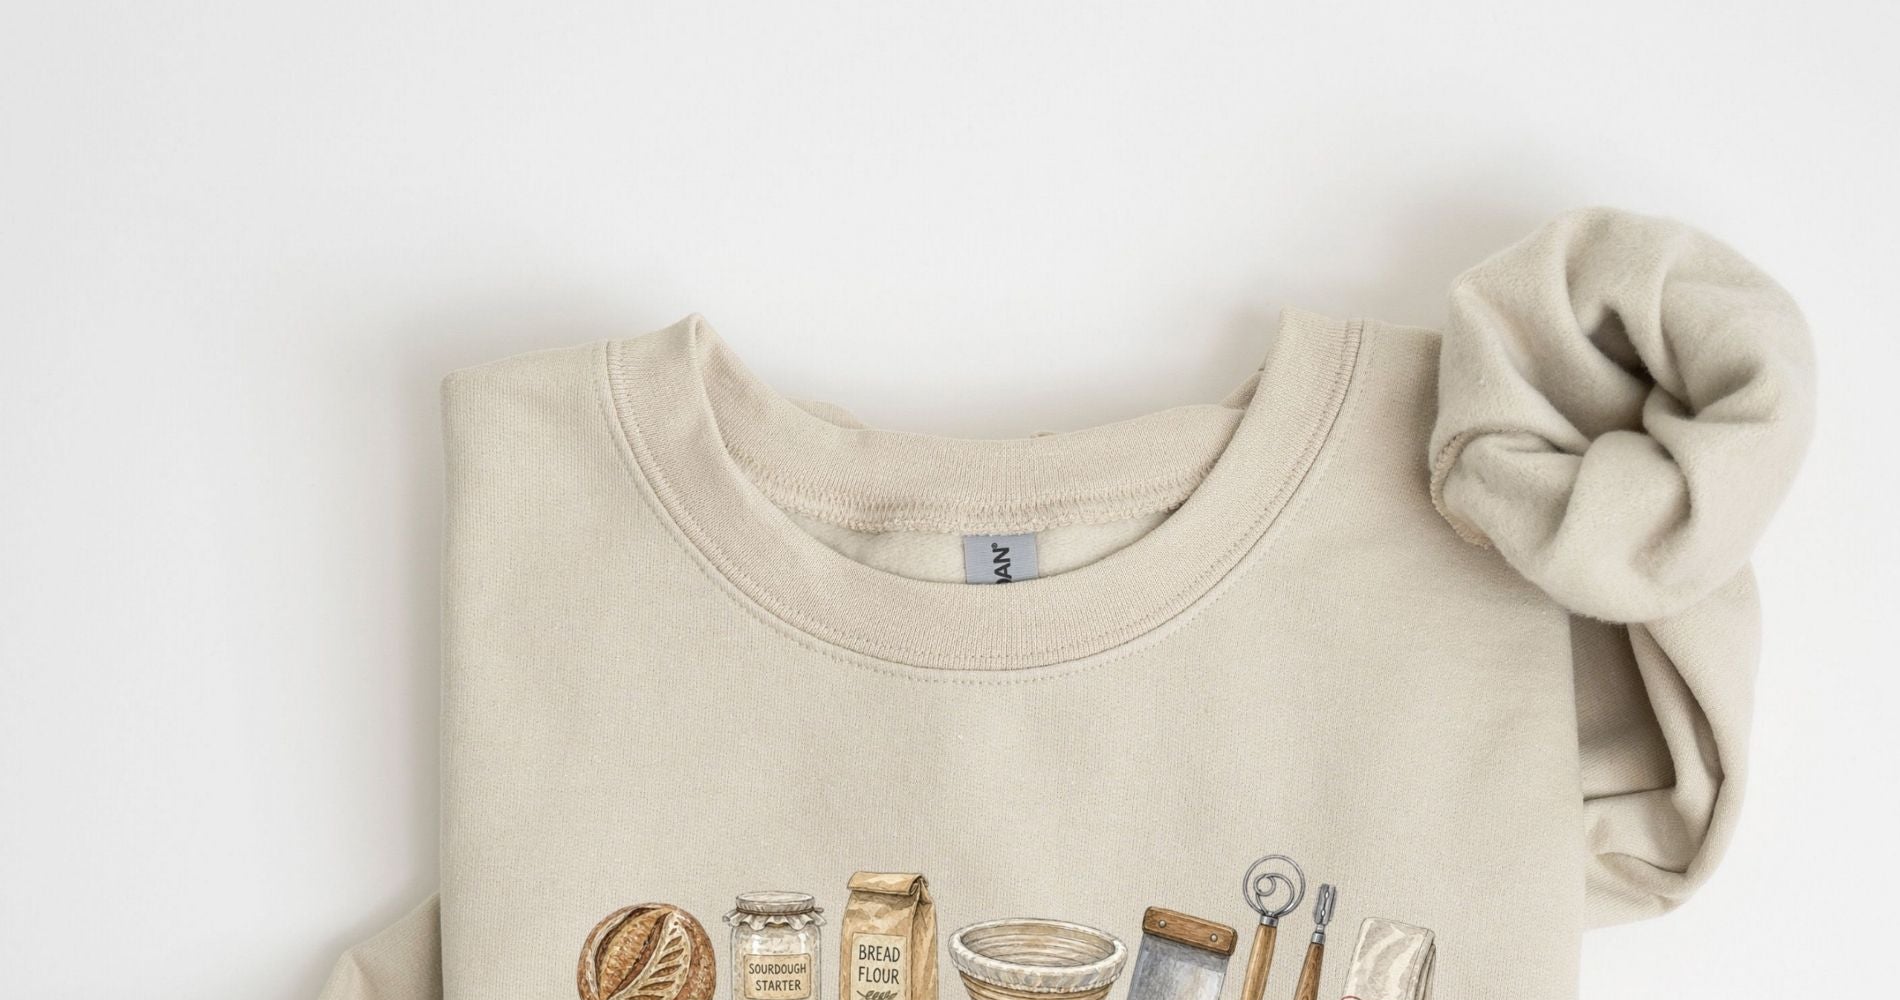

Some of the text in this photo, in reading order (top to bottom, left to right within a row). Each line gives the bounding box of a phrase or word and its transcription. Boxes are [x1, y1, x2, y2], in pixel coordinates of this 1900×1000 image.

[858, 944, 901, 963] BREAD
[748, 962, 807, 975] SOURDOUGH
[858, 966, 900, 985] FLOUR
[755, 979, 802, 992] STARTER
